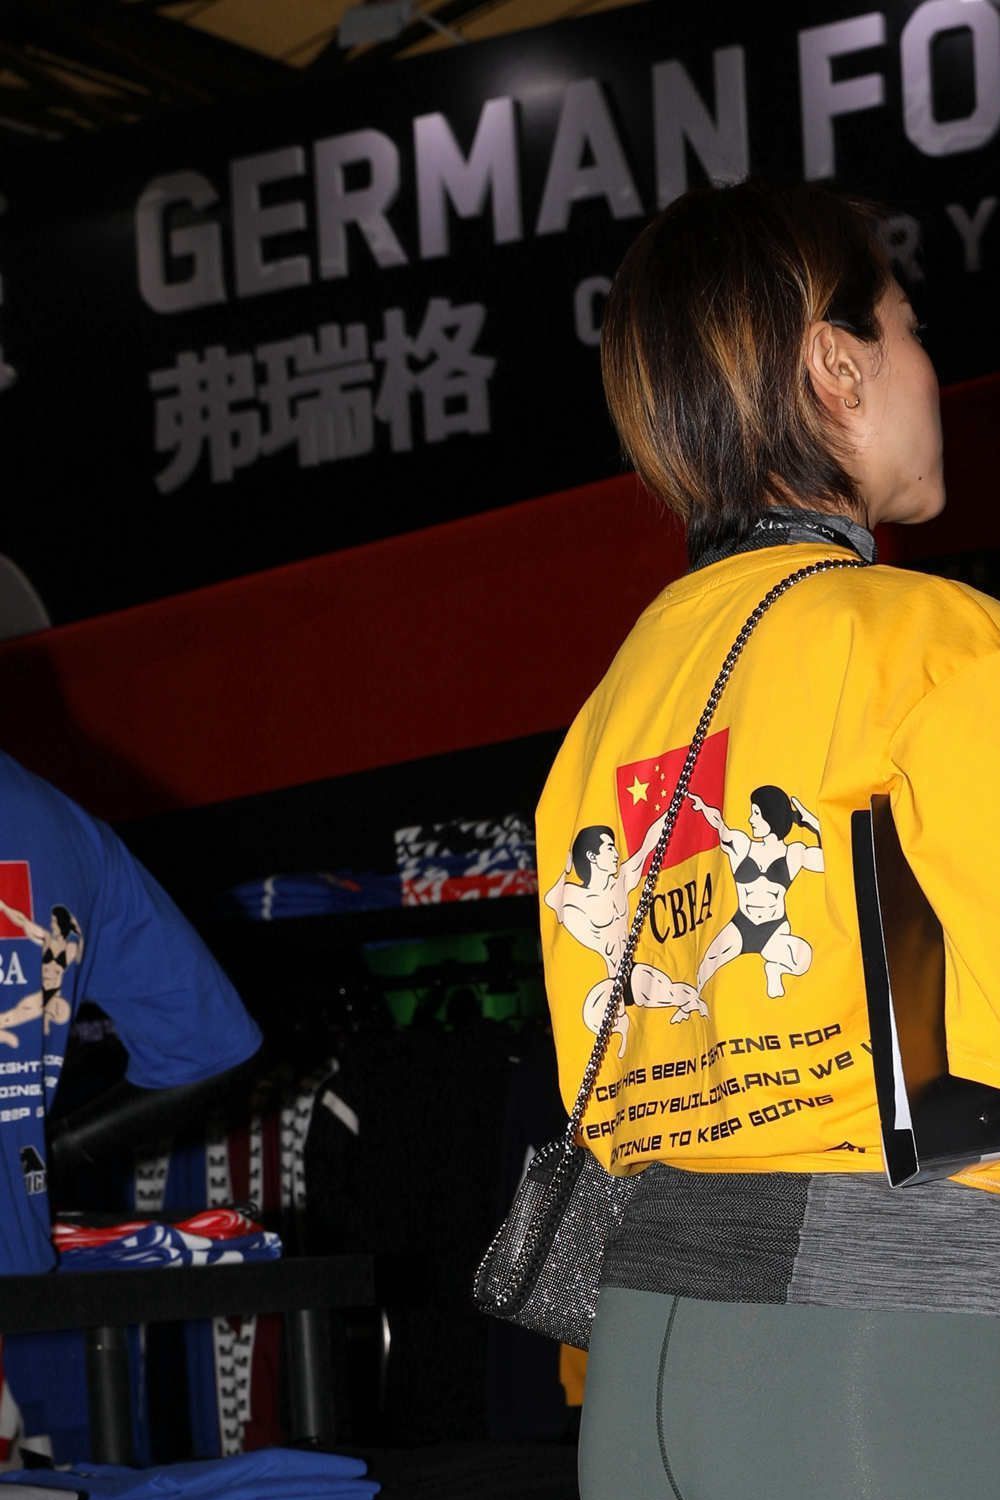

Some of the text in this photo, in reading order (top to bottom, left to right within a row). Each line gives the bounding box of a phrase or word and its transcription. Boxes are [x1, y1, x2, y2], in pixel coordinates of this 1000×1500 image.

[135, 44, 749, 314] GERMAN
[148, 298, 497, 495] 弗瑞格
[652, 1058, 697, 1080] BEEN
[788, 1023, 841, 1049] FOR
[809, 1050, 854, 1079] WE
[611, 1094, 834, 1160] NTINUE TO KEEP GOING
